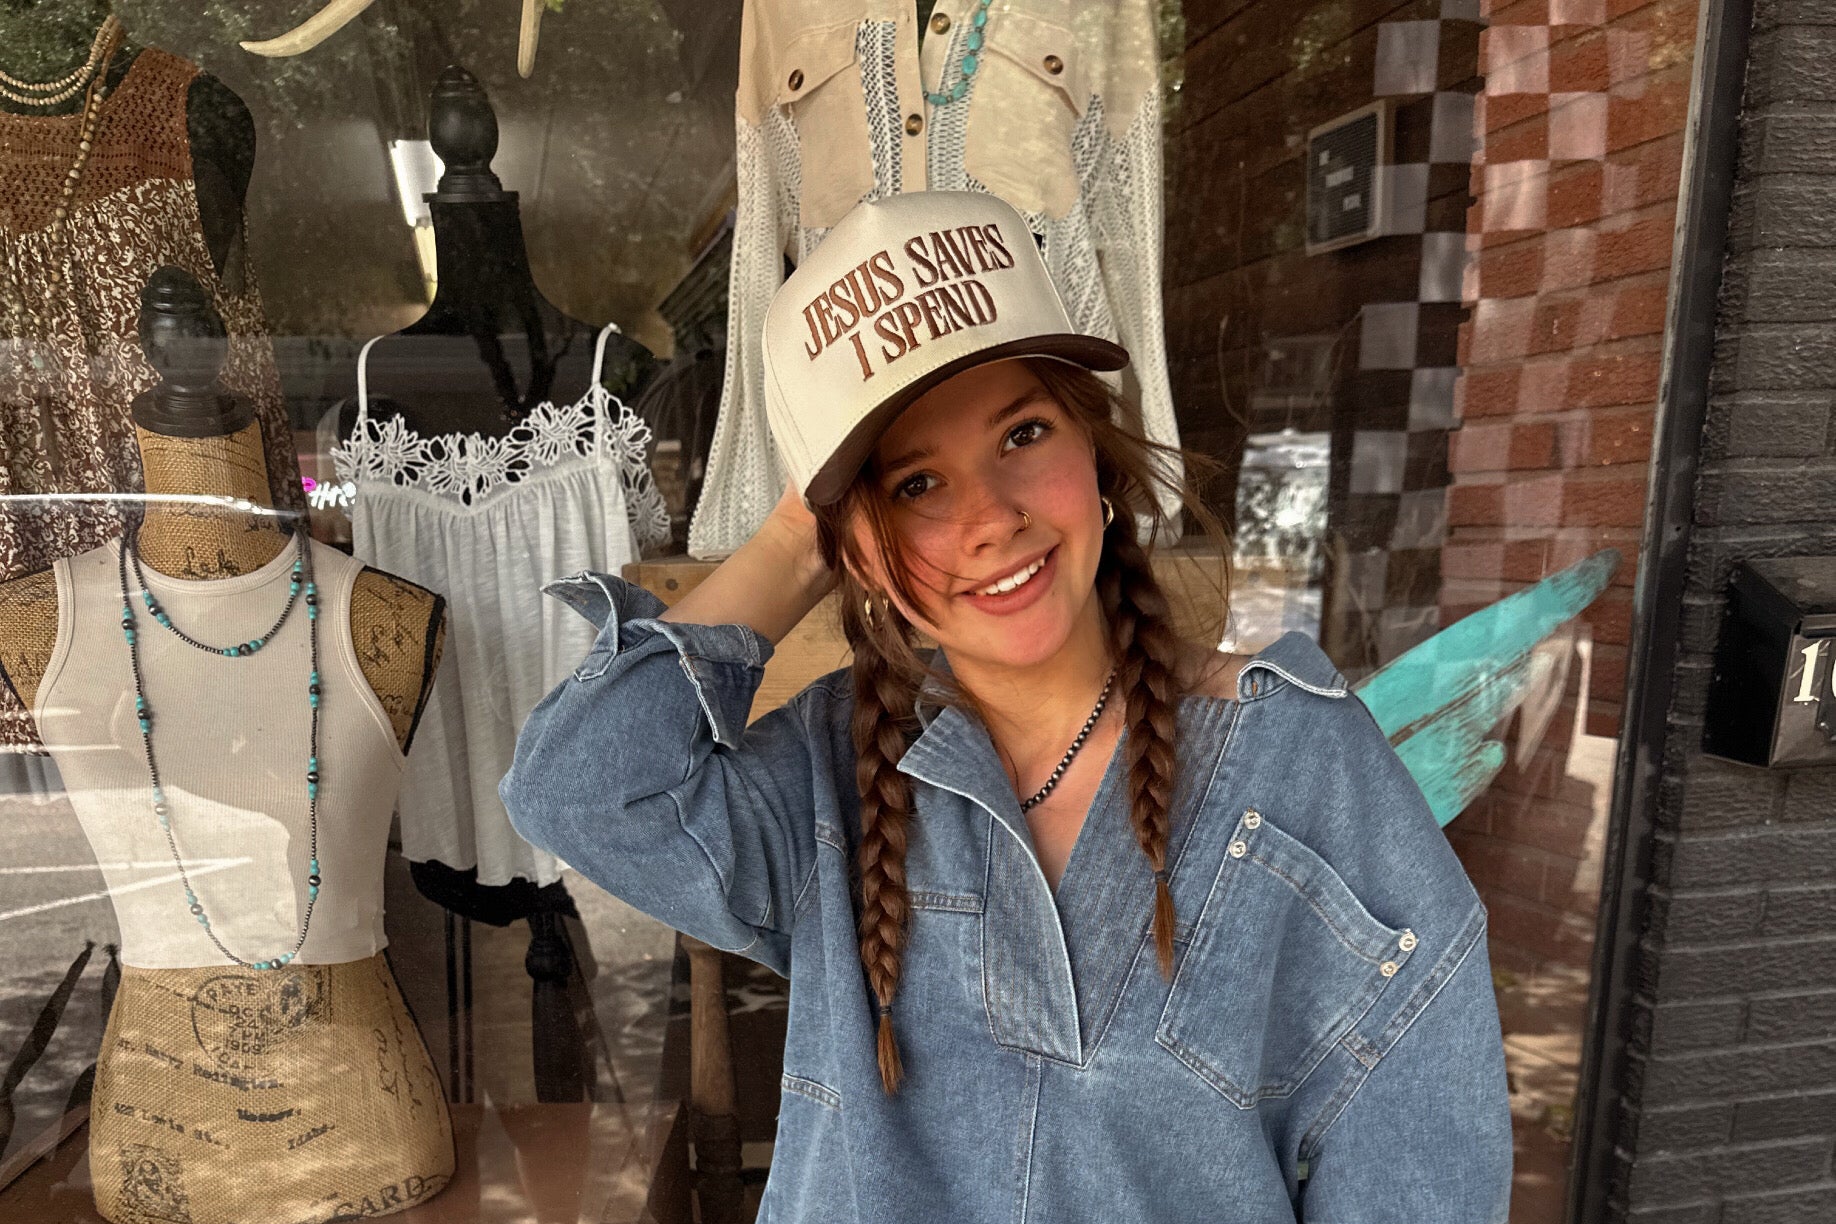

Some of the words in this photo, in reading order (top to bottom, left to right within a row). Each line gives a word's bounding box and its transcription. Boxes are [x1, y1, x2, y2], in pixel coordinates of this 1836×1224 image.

[802, 250, 904, 361] JESUS
[904, 224, 1015, 289] SAVES
[848, 331, 875, 382] I
[873, 279, 998, 364] SPEND
[1793, 639, 1836, 703] 1
[333, 1174, 426, 1219] CARD
